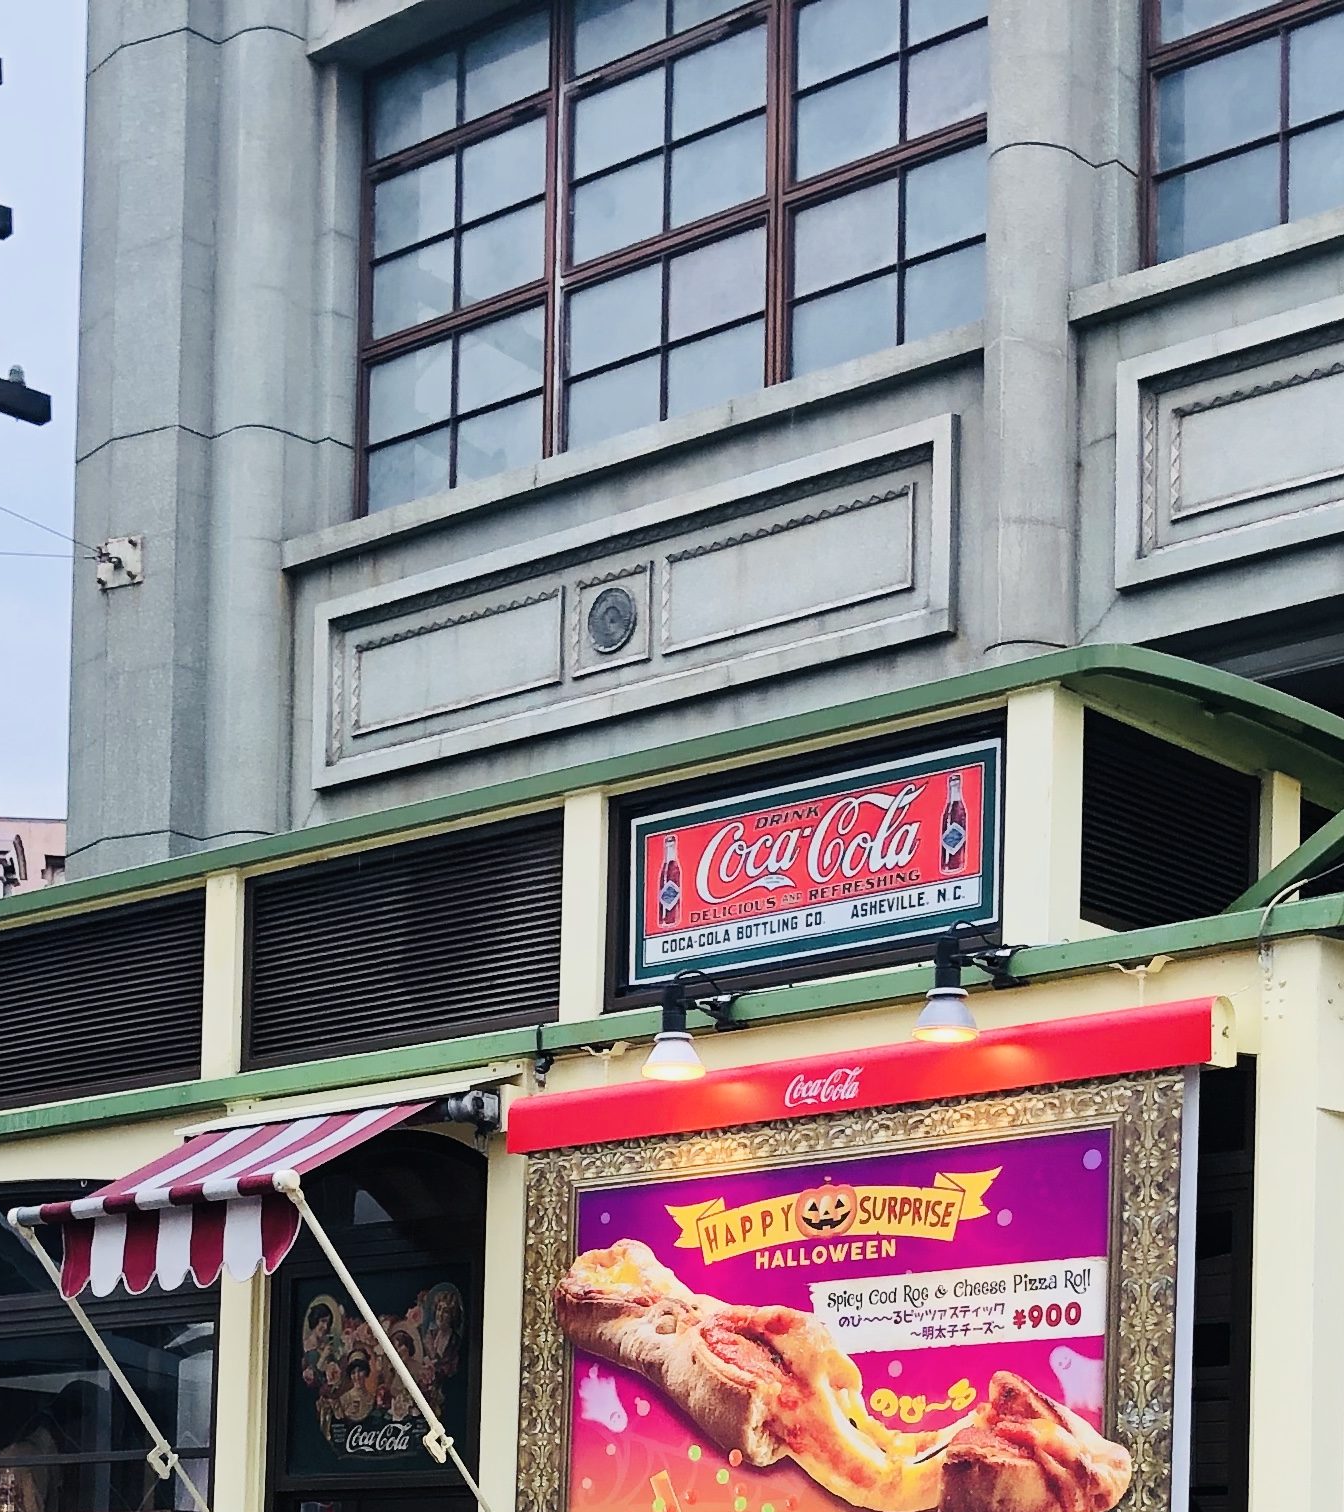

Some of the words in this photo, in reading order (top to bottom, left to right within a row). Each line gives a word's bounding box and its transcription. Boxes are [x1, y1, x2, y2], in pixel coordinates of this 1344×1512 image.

[754, 804, 821, 831] DRINK
[696, 781, 929, 905] Coca-Cola
[689, 895, 777, 925] DELICIOUS
[781, 892, 803, 906] AND
[808, 869, 921, 902] REFRESHING
[661, 929, 731, 954] COCA-COLA
[736, 913, 799, 941] BOTTLING
[784, 1066, 863, 1108] Coca-Cola
[705, 1202, 794, 1254] HAPPY
[859, 1195, 956, 1228] SURPRISE
[756, 1239, 896, 1270] HALLOWEEN
[827, 1291, 863, 1312] Spicy
[869, 1287, 897, 1304] Cod
[904, 1284, 929, 1309] Roe
[934, 1286, 948, 1298] &
[953, 1278, 1006, 1298] Cheese
[1013, 1273, 1057, 1293] Pizza
[1064, 1269, 1091, 1294] Roll
[1013, 1301, 1082, 1330] ¥900
[345, 1422, 413, 1453] Coca-Cola
